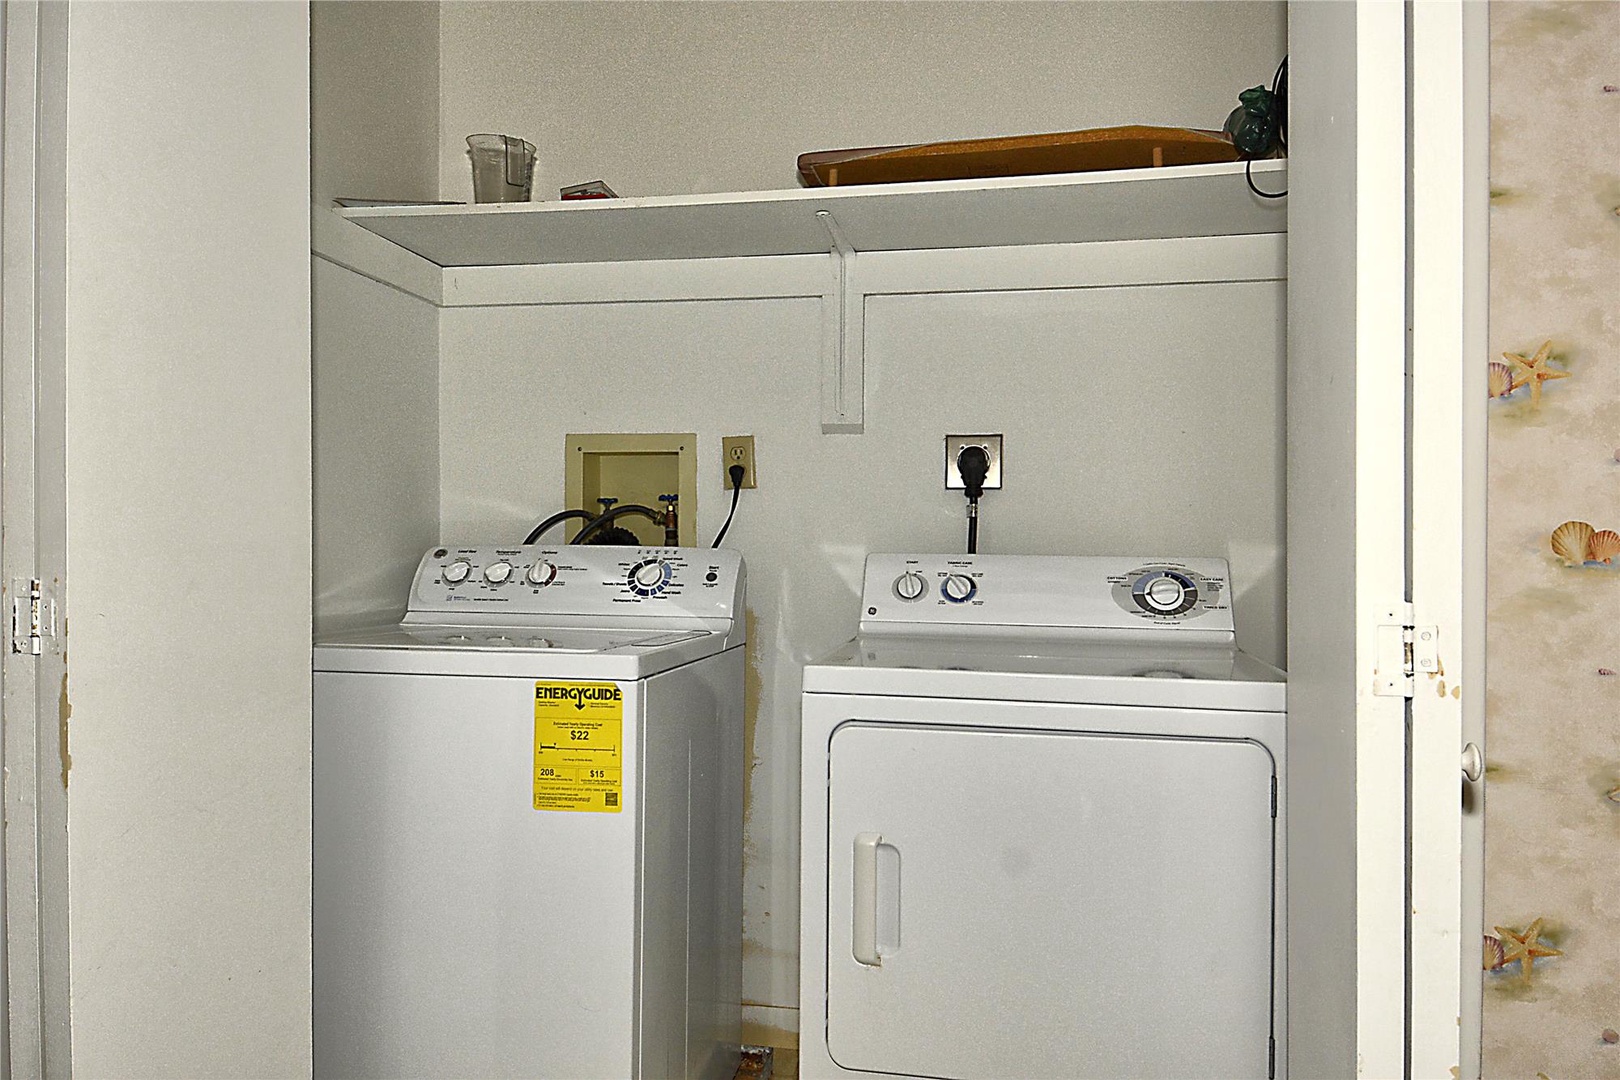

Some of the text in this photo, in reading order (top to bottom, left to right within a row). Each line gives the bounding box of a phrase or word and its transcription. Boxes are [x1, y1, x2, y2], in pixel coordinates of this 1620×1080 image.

[536, 687, 622, 701] ENERGYGUIDE
[570, 730, 589, 741] $22
[540, 768, 555, 777] 208
[590, 770, 604, 779] $15
